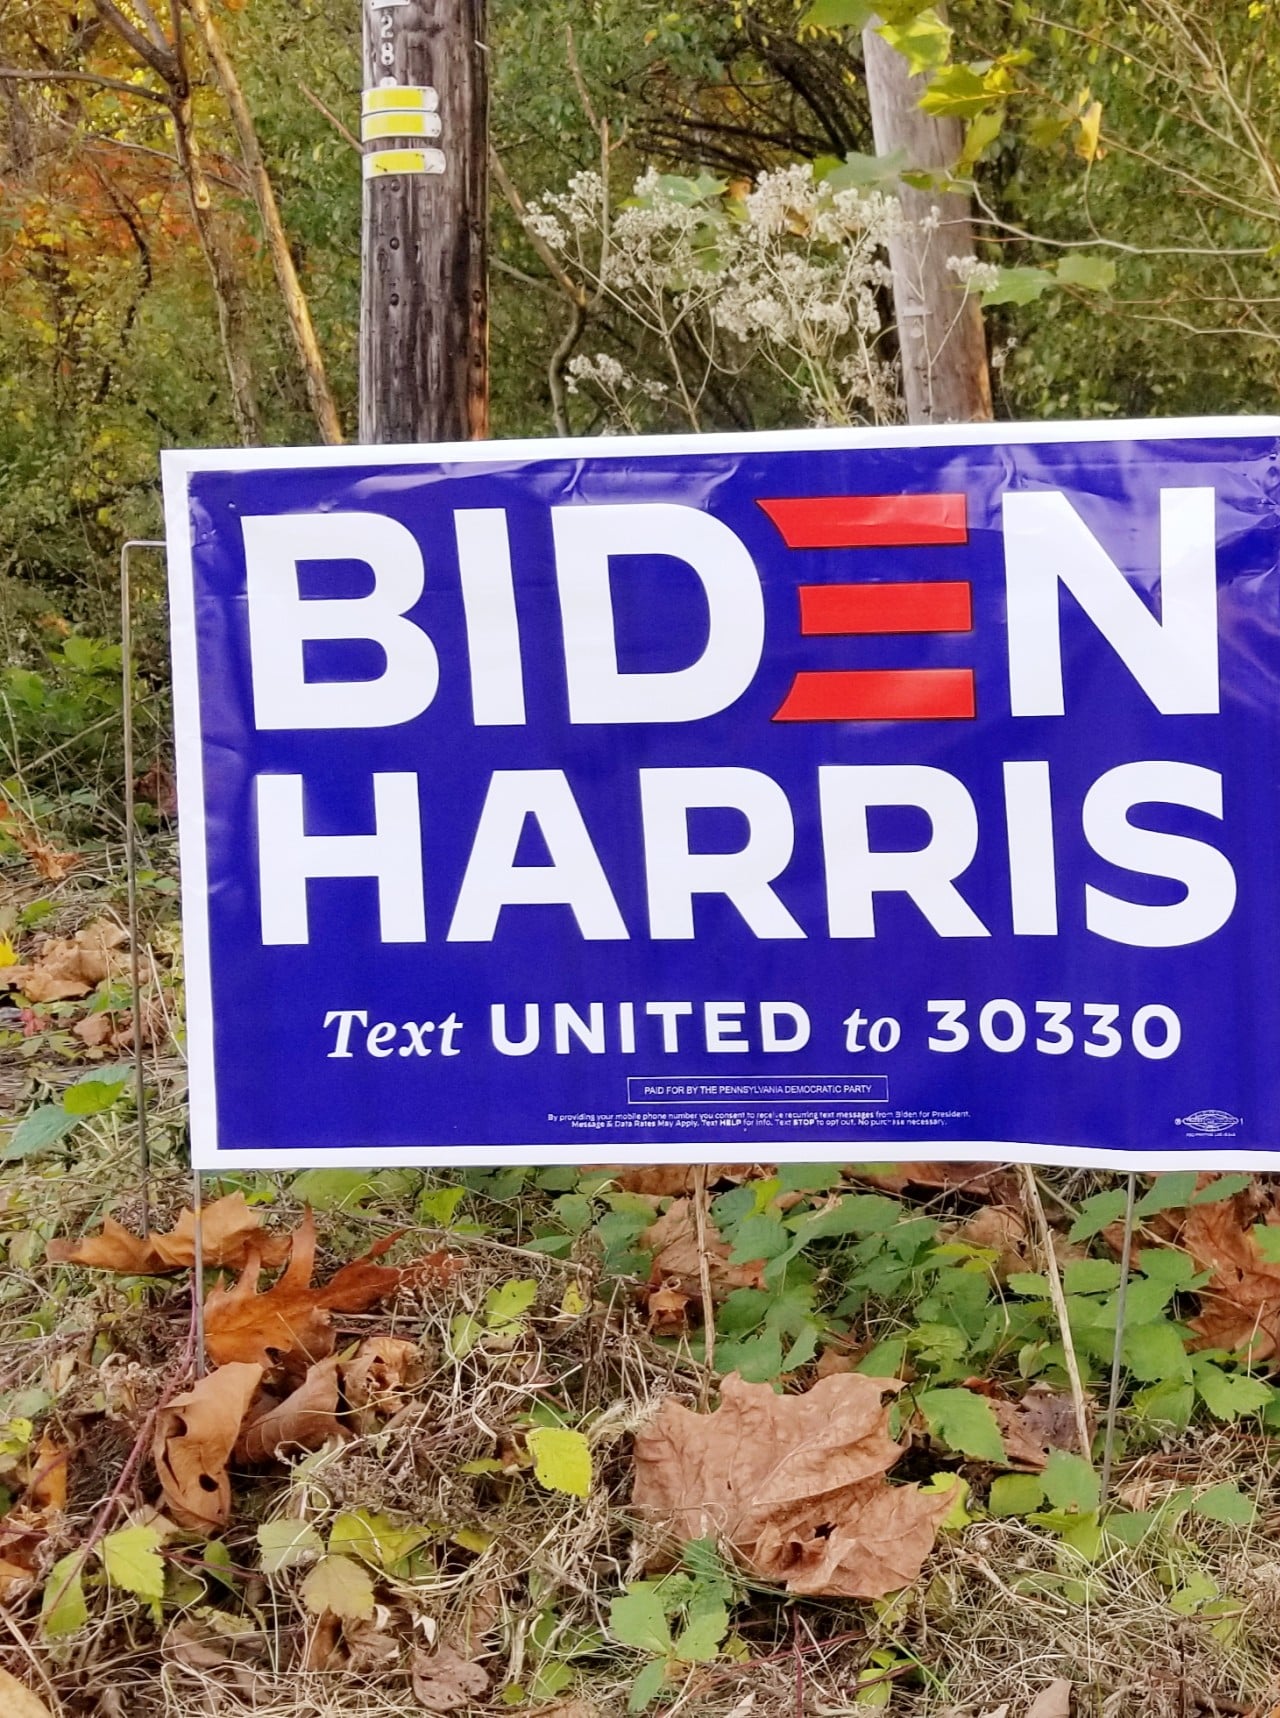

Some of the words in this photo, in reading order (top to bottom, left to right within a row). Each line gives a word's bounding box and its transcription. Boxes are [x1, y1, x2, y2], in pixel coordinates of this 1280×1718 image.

[241, 486, 1220, 729] BIDEN
[256, 761, 1237, 947] HARRIS
[323, 1010, 464, 1058] Text
[491, 1001, 811, 1056] UNITED
[843, 1008, 901, 1053] to
[927, 998, 1181, 1060] 30330
[547, 1113, 558, 1121] By
[644, 1086, 664, 1095] PAID
[666, 1086, 685, 1095] FOR
[686, 1086, 698, 1094] BY
[700, 1086, 718, 1094] THE
[719, 1085, 783, 1094] PENNSYLVANIA
[784, 1085, 842, 1093] DEMOCRATIC
[844, 1084, 872, 1093] PARTY
